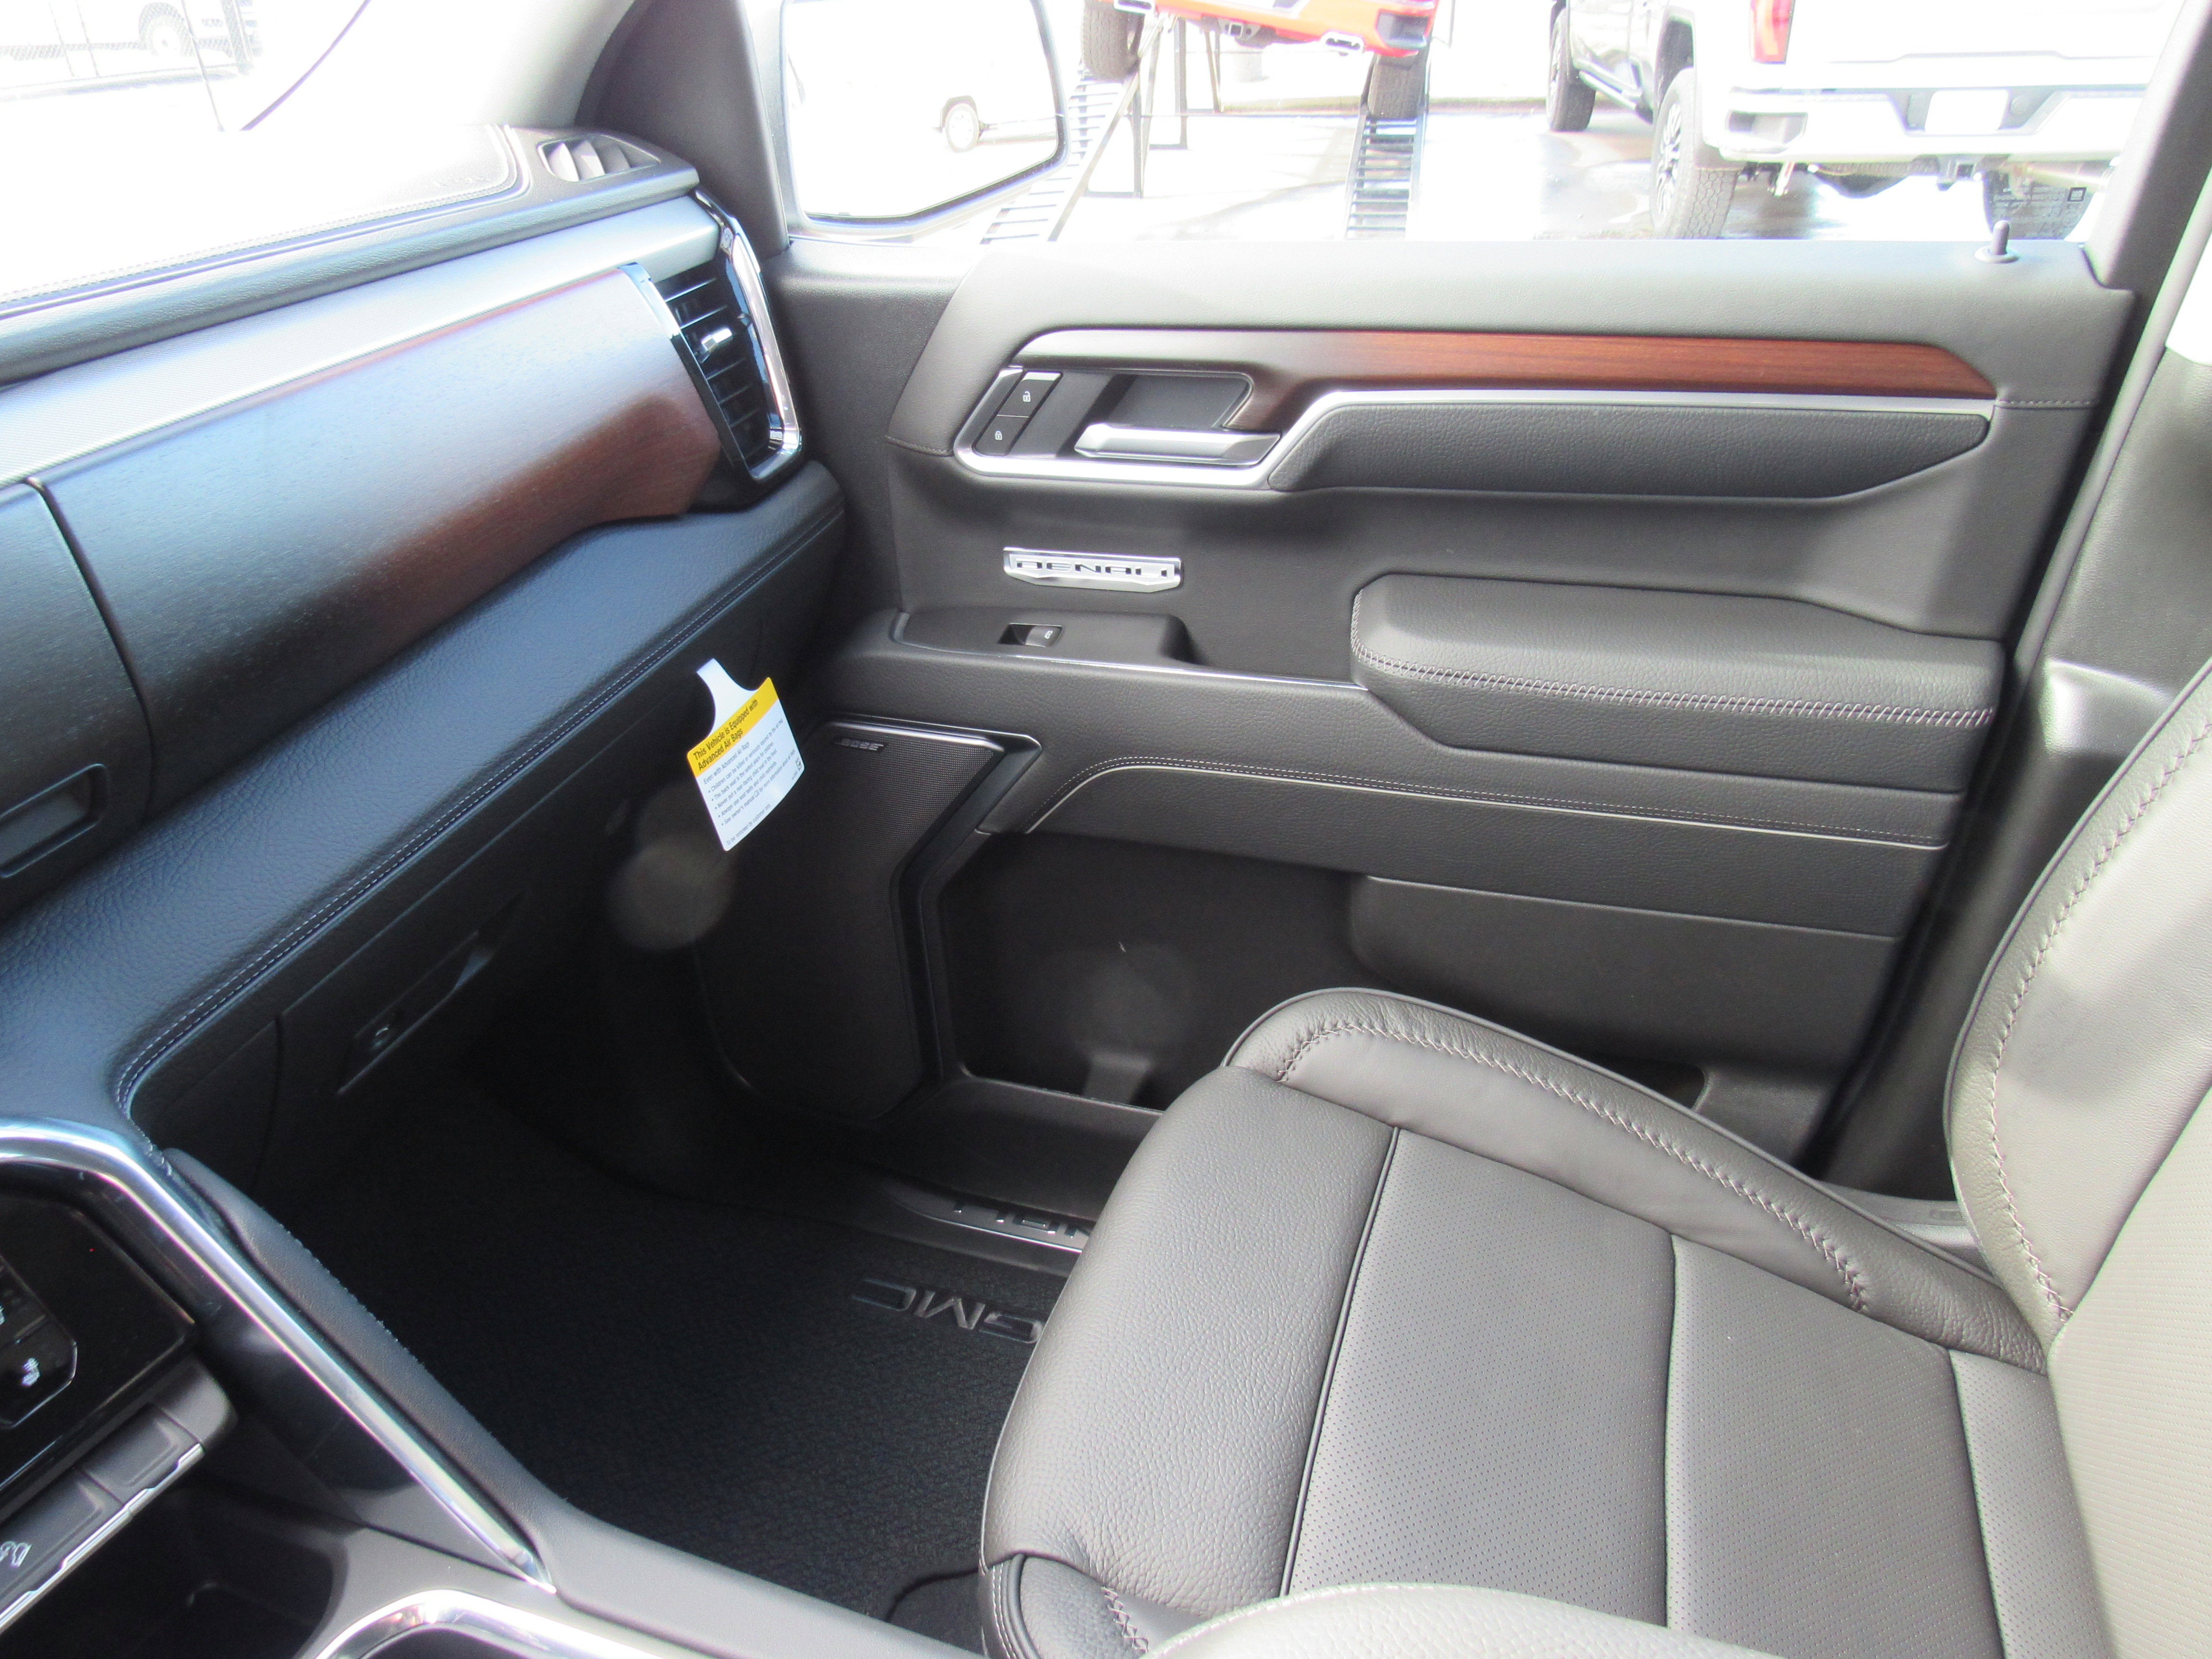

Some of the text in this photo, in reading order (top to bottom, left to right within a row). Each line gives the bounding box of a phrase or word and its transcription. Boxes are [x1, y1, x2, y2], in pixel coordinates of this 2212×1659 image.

[1015, 557, 1168, 579] DENALI
[693, 699, 757, 760] This Vehicle is Equipped with
[698, 728, 743, 771] Advanced Air Bags
[841, 739, 884, 751] BOSE
[852, 1277, 1044, 1344] GMC
